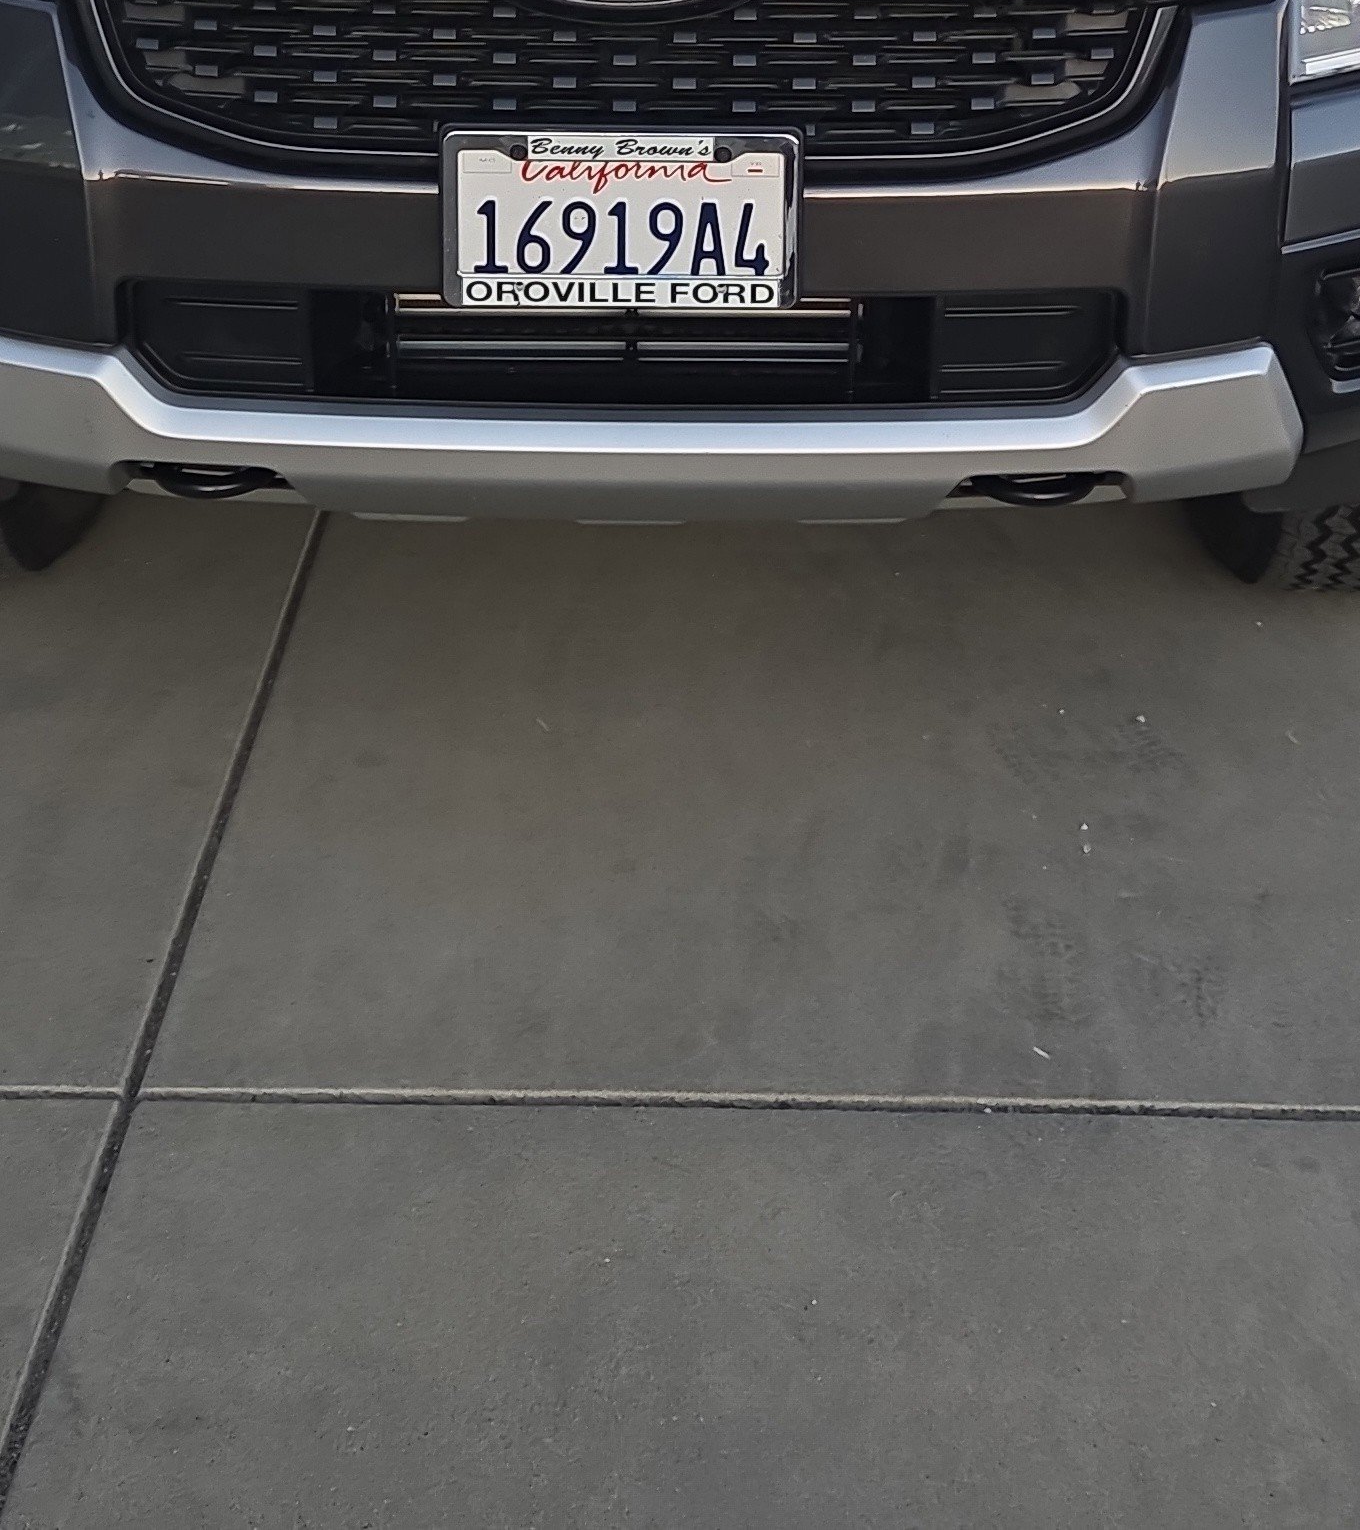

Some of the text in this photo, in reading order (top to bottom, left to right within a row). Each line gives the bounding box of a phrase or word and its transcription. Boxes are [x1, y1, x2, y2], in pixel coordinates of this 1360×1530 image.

[531, 137, 713, 159] Benny Brown's
[521, 160, 732, 194] California
[473, 199, 770, 275] 16919A4
[466, 281, 775, 304] OROVILLE FORD
